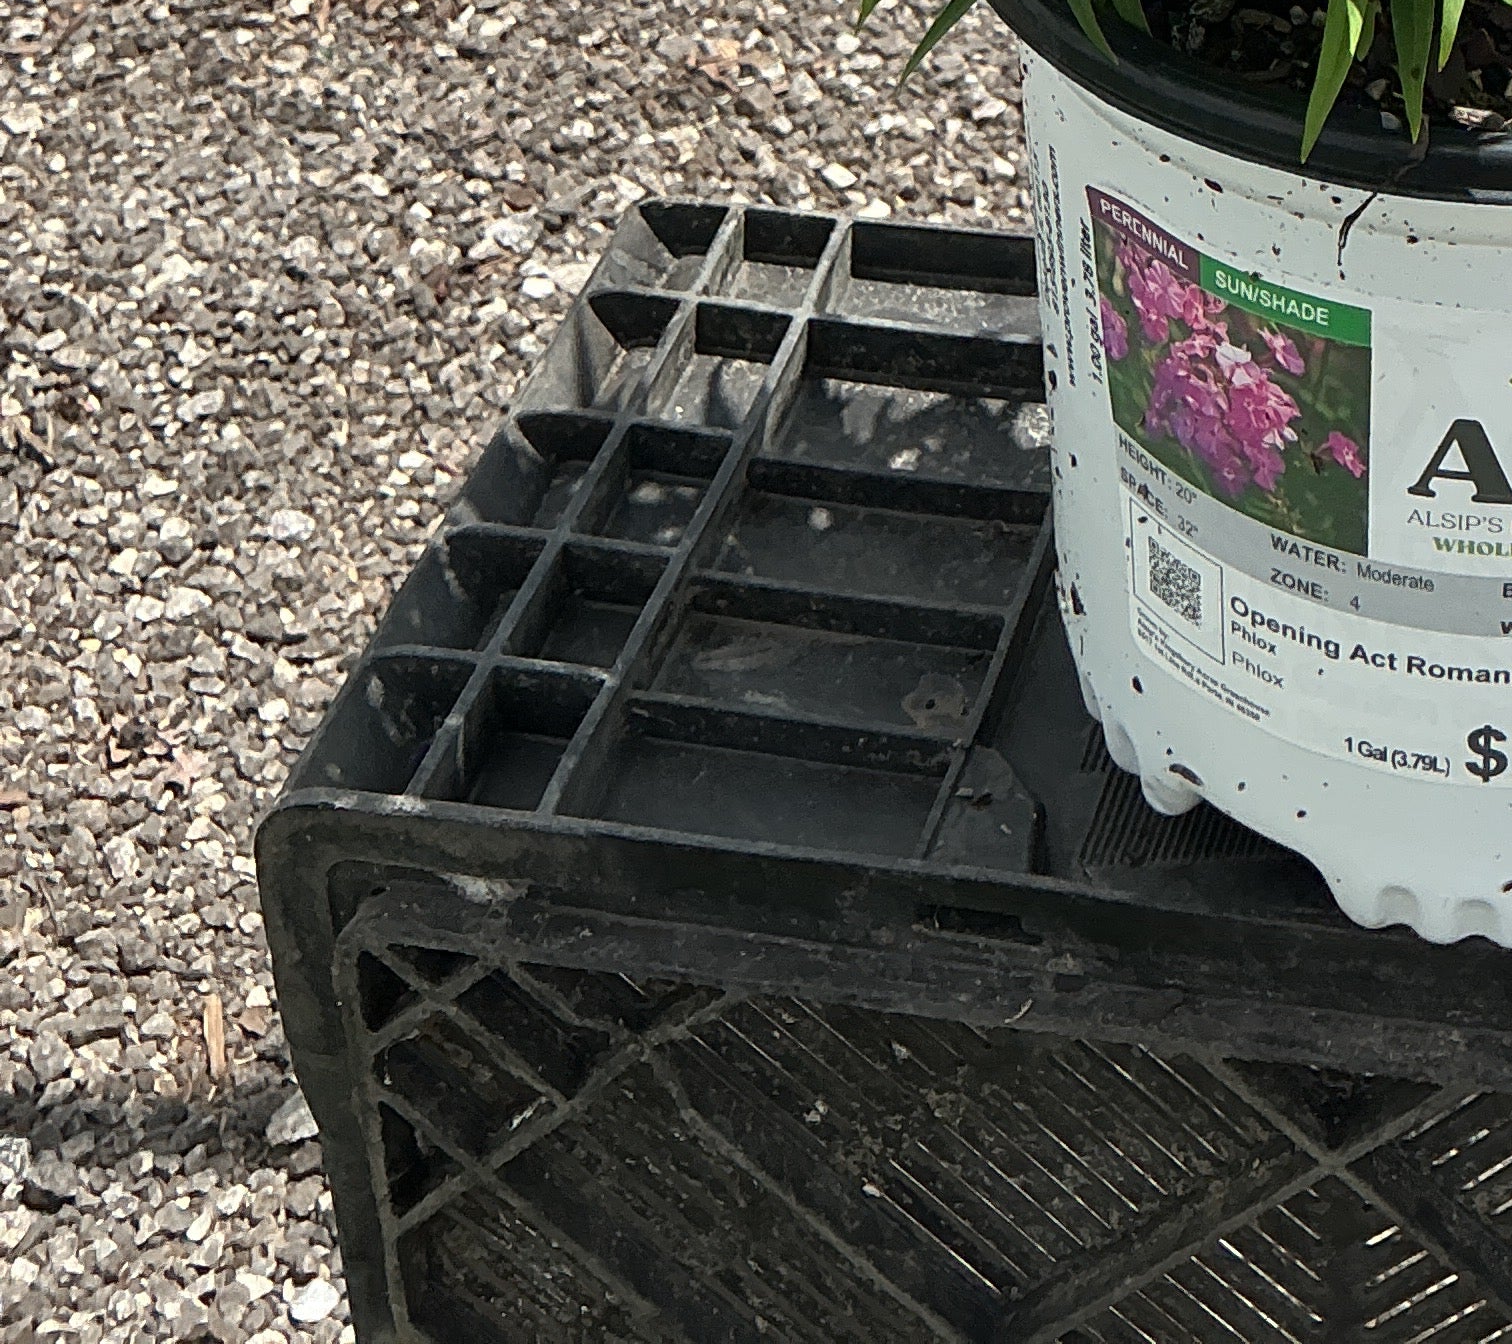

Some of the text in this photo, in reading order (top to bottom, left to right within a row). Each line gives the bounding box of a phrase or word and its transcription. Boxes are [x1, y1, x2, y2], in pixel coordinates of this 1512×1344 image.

[1099, 198, 1190, 270] PERENNIAL
[1214, 269, 1330, 326] SUN/SHADE
[1118, 433, 1173, 491] HEIGHT:
[1119, 465, 1168, 521] SPACE:
[1406, 509, 1503, 533] ALSIP'S
[1270, 567, 1361, 611] ZONE: 4
[1271, 532, 1436, 593] WATER: Moderate
[1230, 595, 1341, 661] Opening
[1349, 644, 1398, 672] Act
[1231, 620, 1277, 656] Phlox
[1232, 651, 1285, 690] Phlox
[1343, 736, 1354, 754] 1
[1356, 738, 1388, 763] Gal
[1390, 746, 1451, 777] (3.79L)
